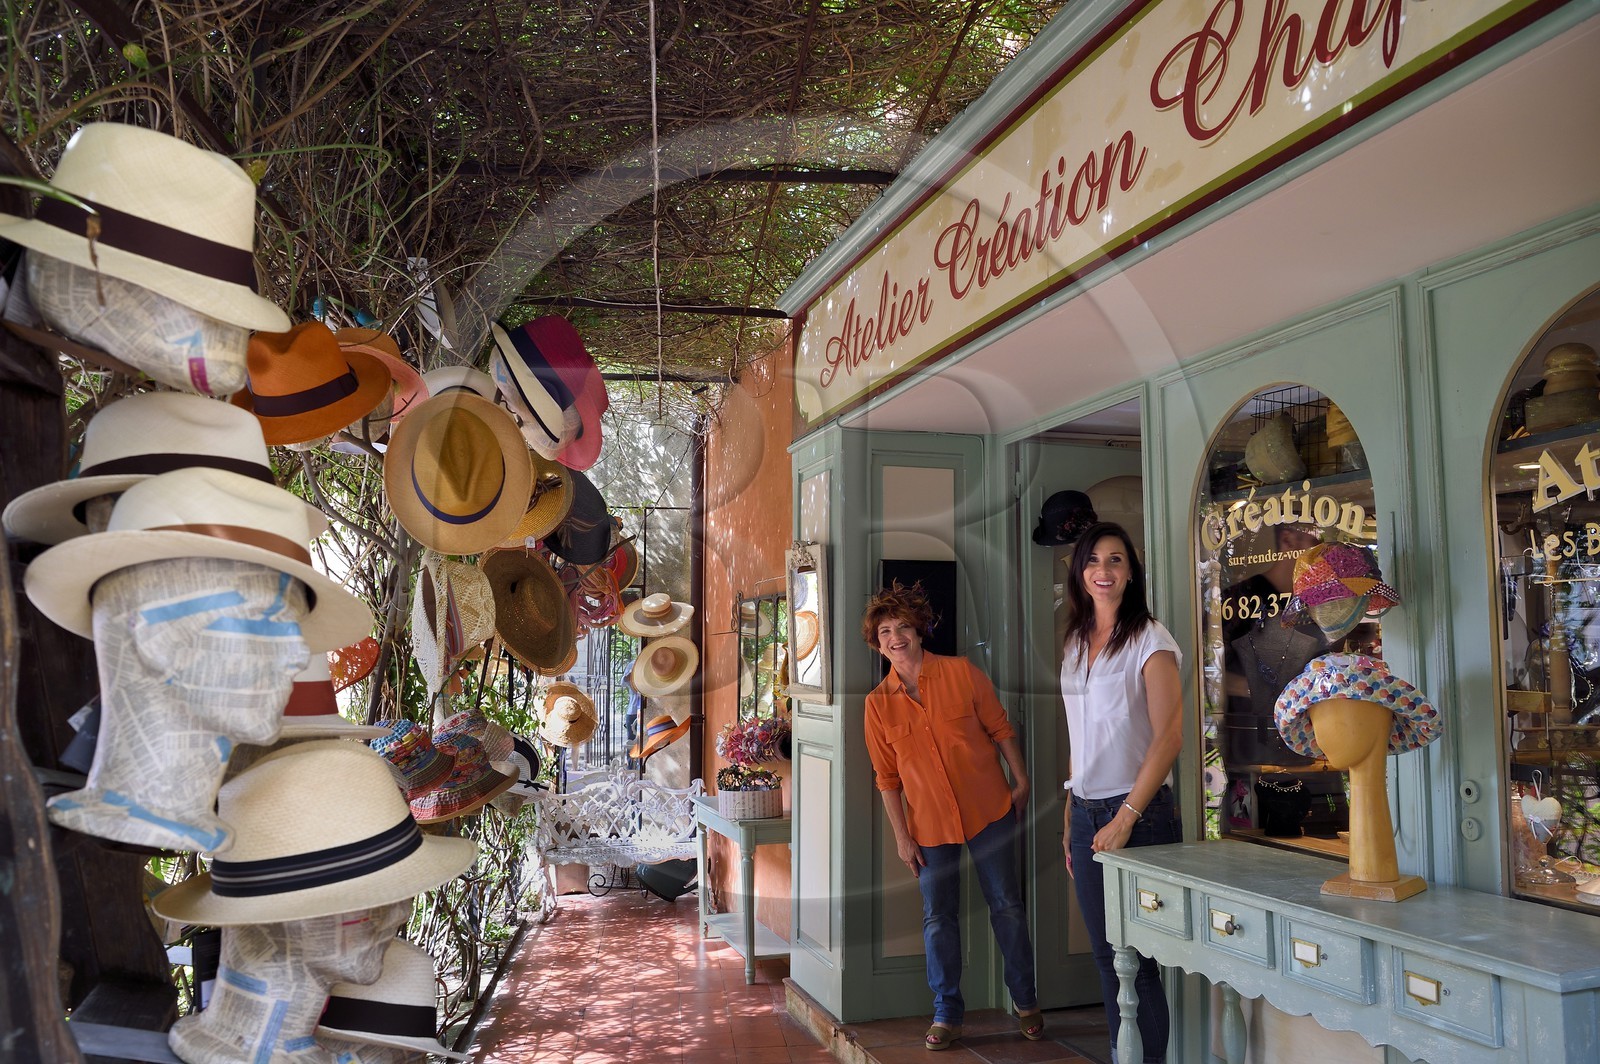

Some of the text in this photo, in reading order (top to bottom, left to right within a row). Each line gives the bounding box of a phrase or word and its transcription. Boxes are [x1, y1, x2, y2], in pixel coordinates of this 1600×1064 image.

[820, 271, 933, 388] Atelier
[934, 130, 1149, 300] Création
[1202, 479, 1366, 550] Création
[1228, 554, 1246, 567] sur
[1238, 595, 1262, 620] 82
